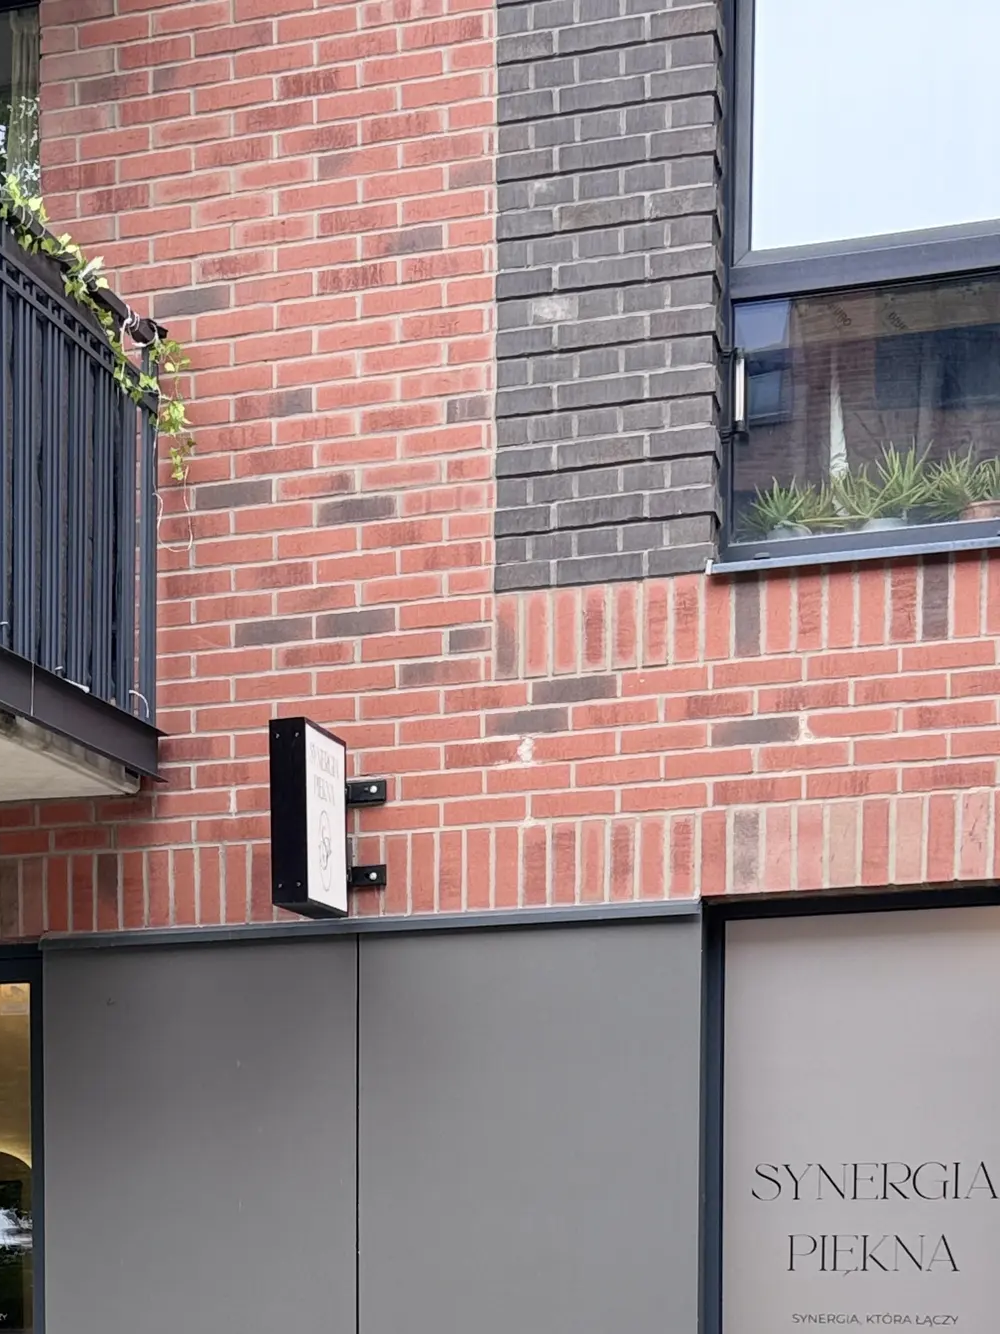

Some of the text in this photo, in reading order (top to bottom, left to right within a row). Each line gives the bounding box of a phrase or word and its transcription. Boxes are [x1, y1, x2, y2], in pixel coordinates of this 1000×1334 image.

[751, 1161, 999, 1201] SYNERGIA
[787, 1234, 960, 1277] PIĘKNA
[866, 1312, 912, 1326] KTÓRA
[915, 1314, 959, 1328] ŁĄCZY
